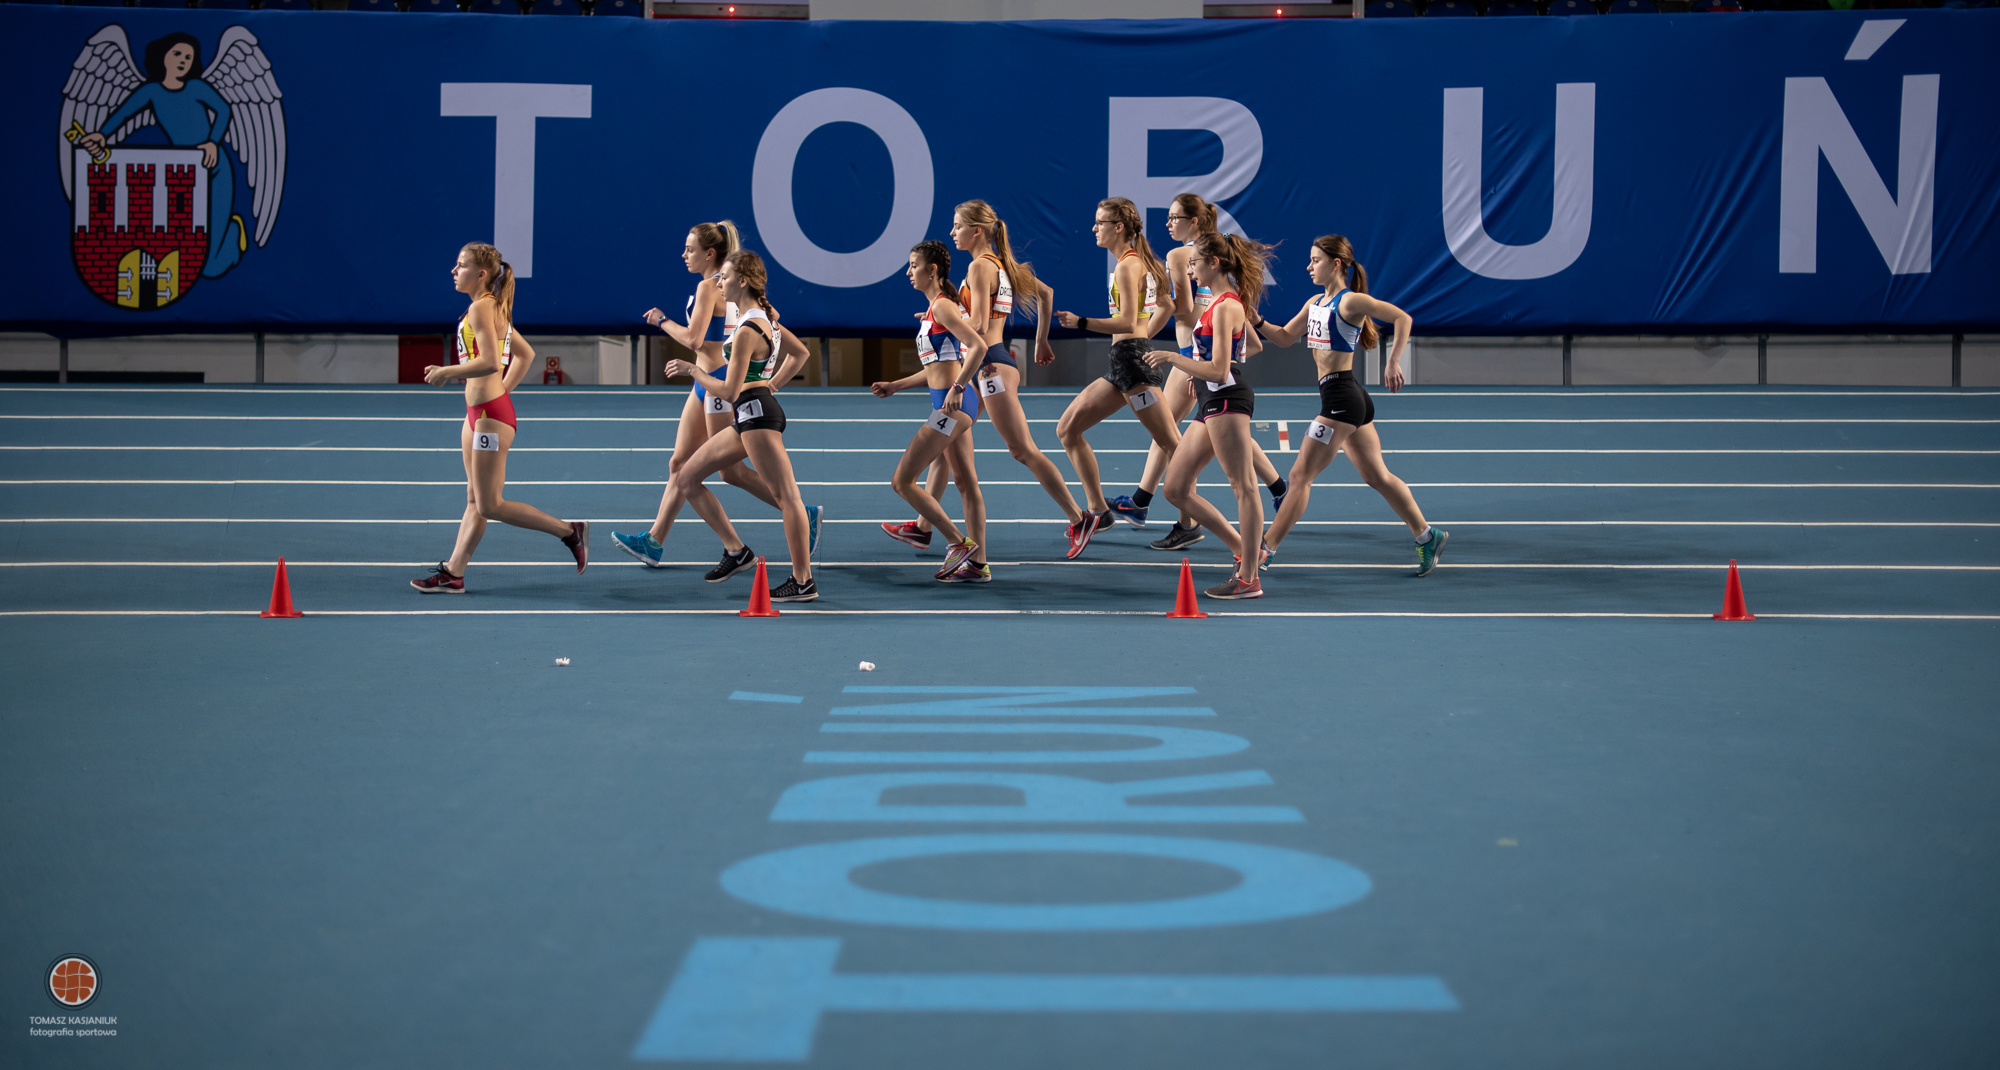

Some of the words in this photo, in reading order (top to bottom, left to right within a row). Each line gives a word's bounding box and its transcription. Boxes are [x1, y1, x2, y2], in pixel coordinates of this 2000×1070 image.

[440, 19, 1940, 287] TORUŃ
[986, 380, 996, 394] 5
[714, 397, 723, 411] 8
[1138, 392, 1147, 405] 7
[936, 417, 949, 430] 4
[1315, 425, 1326, 438] 3
[633, 685, 1460, 1062] TORUŃ
